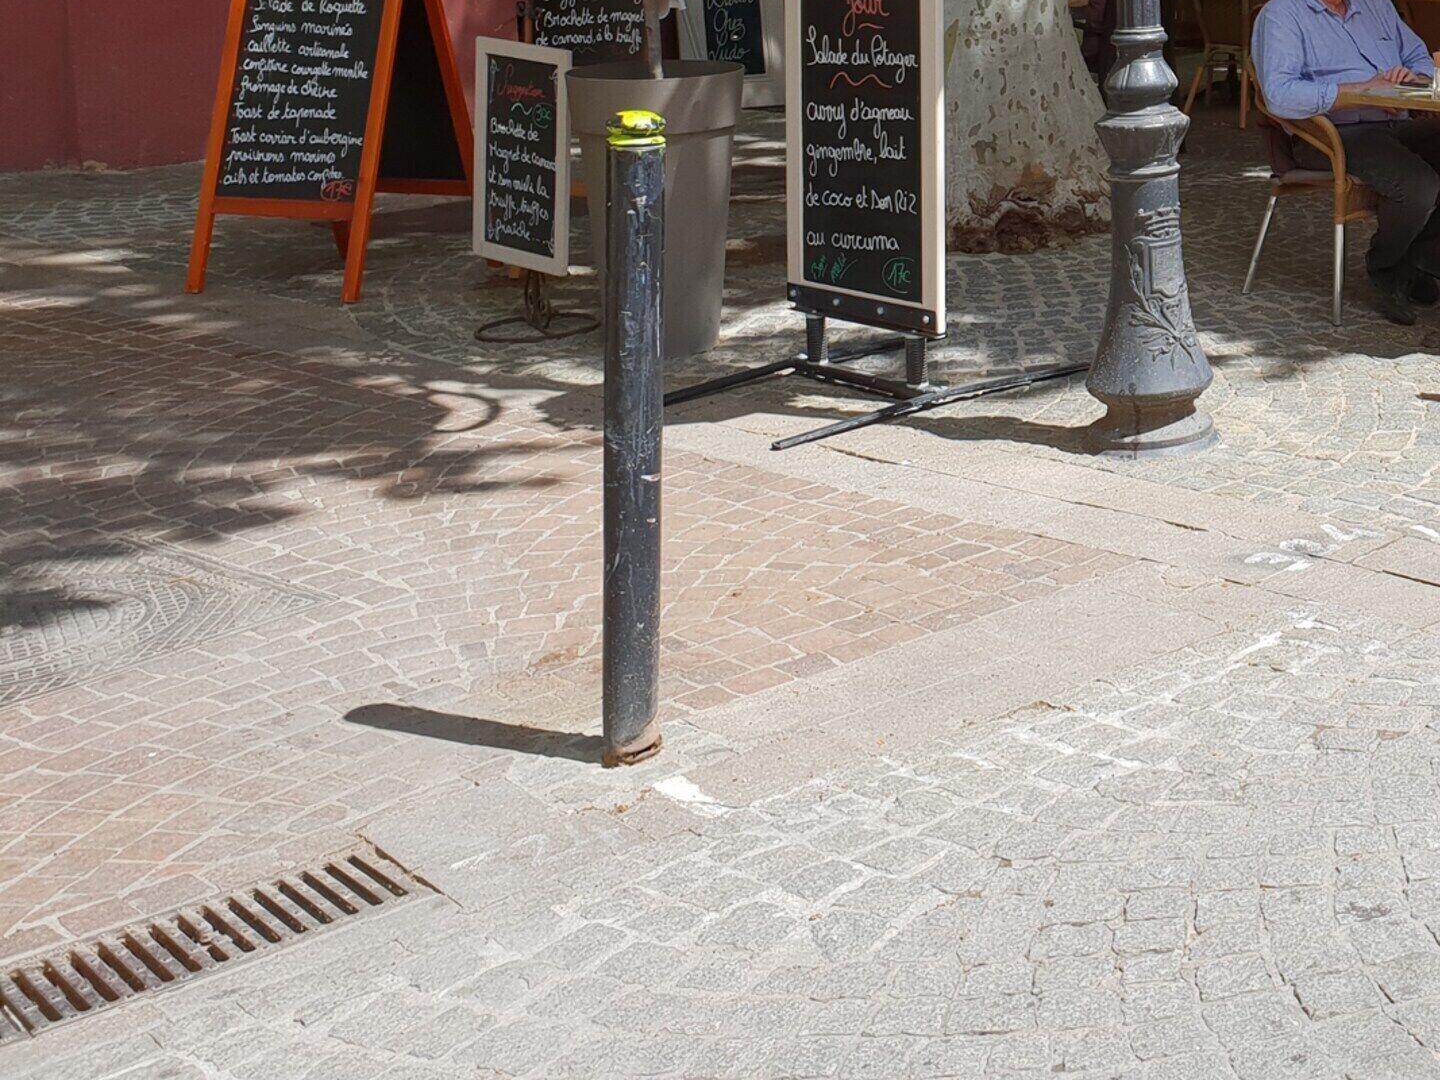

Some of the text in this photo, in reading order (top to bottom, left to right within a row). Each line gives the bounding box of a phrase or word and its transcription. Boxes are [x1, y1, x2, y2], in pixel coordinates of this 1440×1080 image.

[543, 6, 645, 32] Brochette de magret
[535, 31, 549, 46] de
[604, 24, 614, 41] la
[805, 25, 919, 84] Salade du Potager
[332, 60, 369, 79] menthe
[287, 79, 299, 95] de
[267, 104, 281, 120] de
[281, 101, 337, 128] tapenade
[850, 96, 915, 140] d'agneau
[298, 127, 363, 158] d'aubergine
[527, 122, 540, 142] de
[520, 145, 532, 165] de
[878, 130, 907, 160] lait
[248, 169, 260, 184] et
[260, 167, 306, 184] tomates
[536, 174, 551, 199] la
[805, 182, 820, 208] de
[821, 189, 854, 208] coco
[855, 184, 869, 209] et
[806, 230, 900, 251] au curcuma
